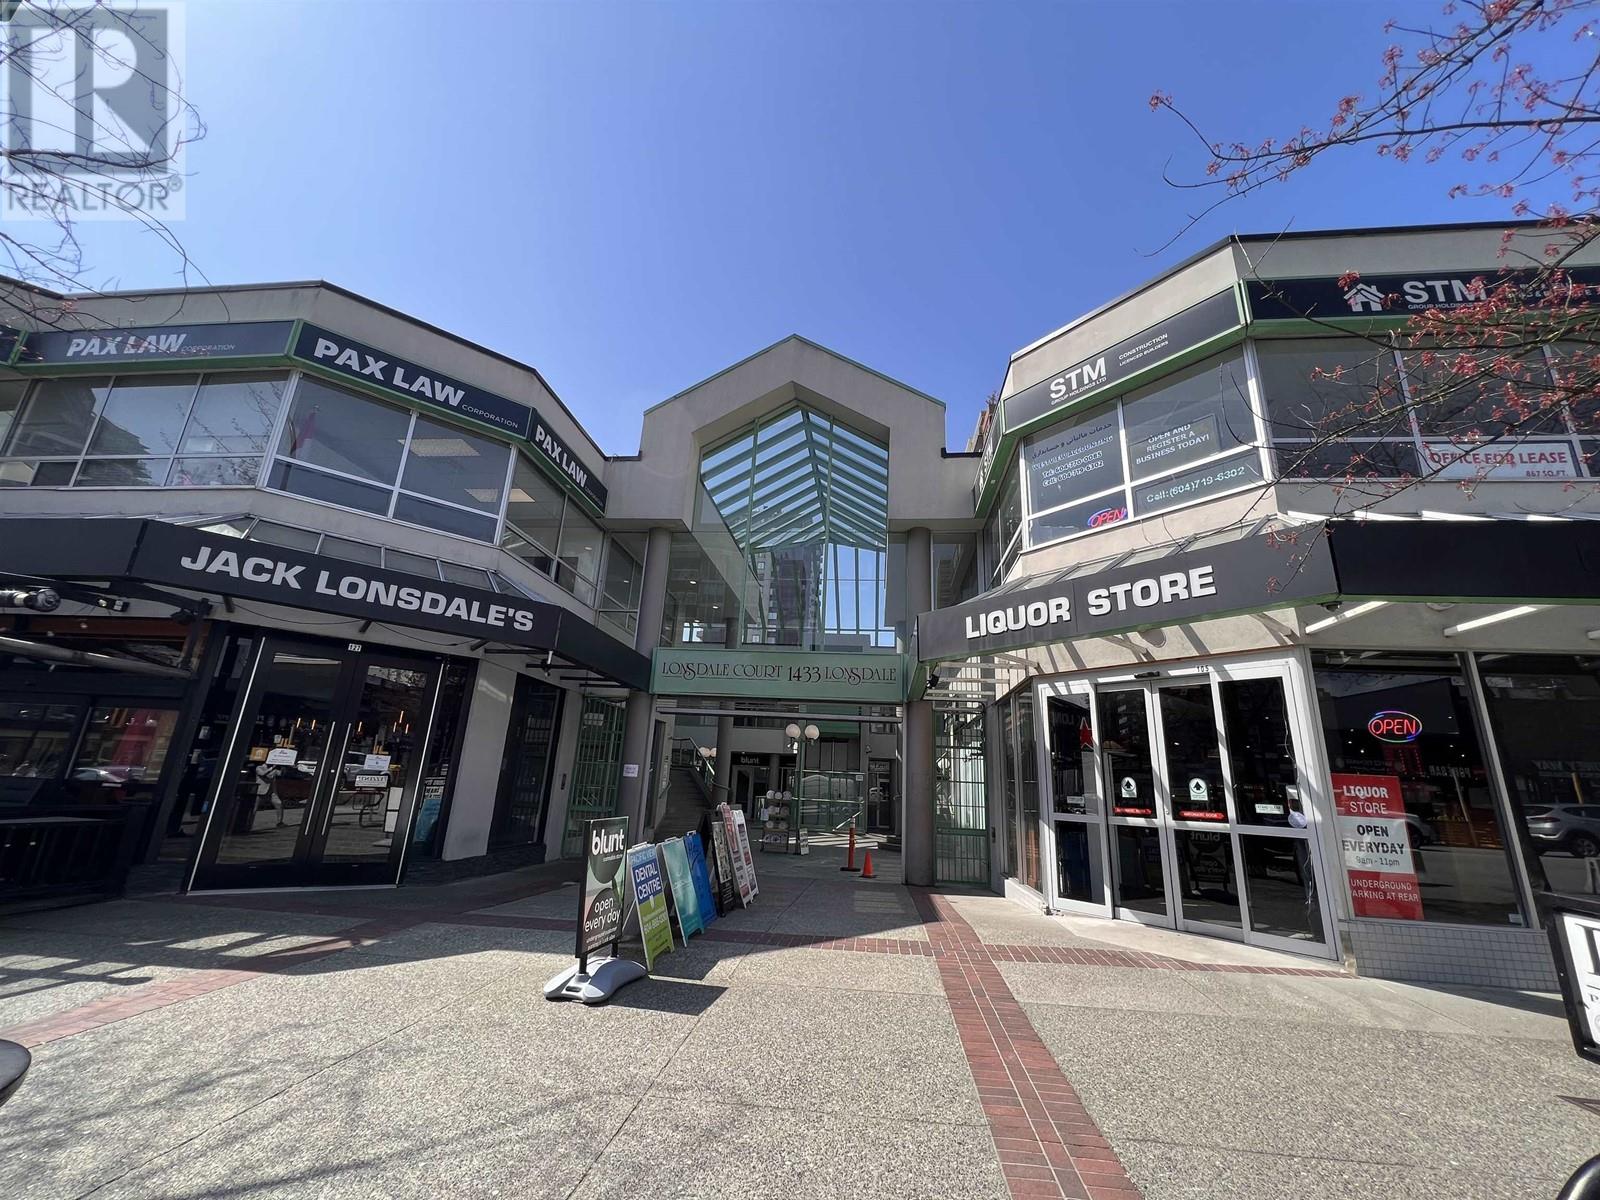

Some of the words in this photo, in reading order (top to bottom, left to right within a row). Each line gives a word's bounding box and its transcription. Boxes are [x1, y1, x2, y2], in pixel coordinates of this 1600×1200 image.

[1403, 279, 1487, 304] STM
[66, 336, 124, 357] PAX
[124, 333, 187, 355] LAW
[1118, 333, 1168, 360] CONSTRUCTION
[1119, 352, 1143, 367] LICENCED
[1143, 340, 1169, 356] BUILDERS
[313, 337, 388, 381] PAX
[392, 366, 465, 407] LAW
[461, 404, 519, 429] CORPORATION
[1050, 356, 1107, 399] STM
[1050, 393, 1069, 406] GROUP
[1069, 382, 1096, 397] HOLDINGS
[1146, 434, 1187, 453] REGISTER
[1189, 430, 1196, 438] A
[1148, 431, 1171, 444] OPEN
[1172, 423, 1191, 435] AND
[535, 424, 561, 463] PAX
[562, 456, 588, 488] LAW
[1136, 446, 1176, 465] BUSINESS
[1432, 451, 1481, 465] OFFICE
[1484, 452, 1516, 465] FOR
[1519, 452, 1567, 464] LEASE
[1090, 507, 1126, 527] OPEN
[180, 546, 307, 590] JACK
[315, 570, 535, 632] LONSDALE'S
[965, 596, 1071, 639] LIQUOR
[1087, 565, 1218, 617] STORE
[662, 661, 730, 681] LONSDALE
[733, 663, 783, 678] COURT
[787, 666, 821, 683] 1433
[824, 665, 897, 686] LONSDALE
[1371, 718, 1416, 735] OPEN
[740, 755, 760, 765] blunt
[1343, 785, 1389, 799] LIQUOR
[1350, 801, 1388, 815] STORE
[1357, 824, 1389, 838] OPEN
[592, 829, 625, 856] blunt
[1342, 839, 1405, 855] EVERYDAY
[1380, 857, 1400, 867] 11pm
[635, 864, 658, 883] DENTAL
[1350, 878, 1412, 891] UNDERGROUND
[637, 877, 662, 900] CENTRE
[1351, 888, 1385, 900] ARKING
[1386, 892, 1396, 901] AT
[1398, 892, 1419, 902] REAR
[594, 897, 614, 914] open
[584, 913, 607, 933] every
[607, 909, 621, 924] day
